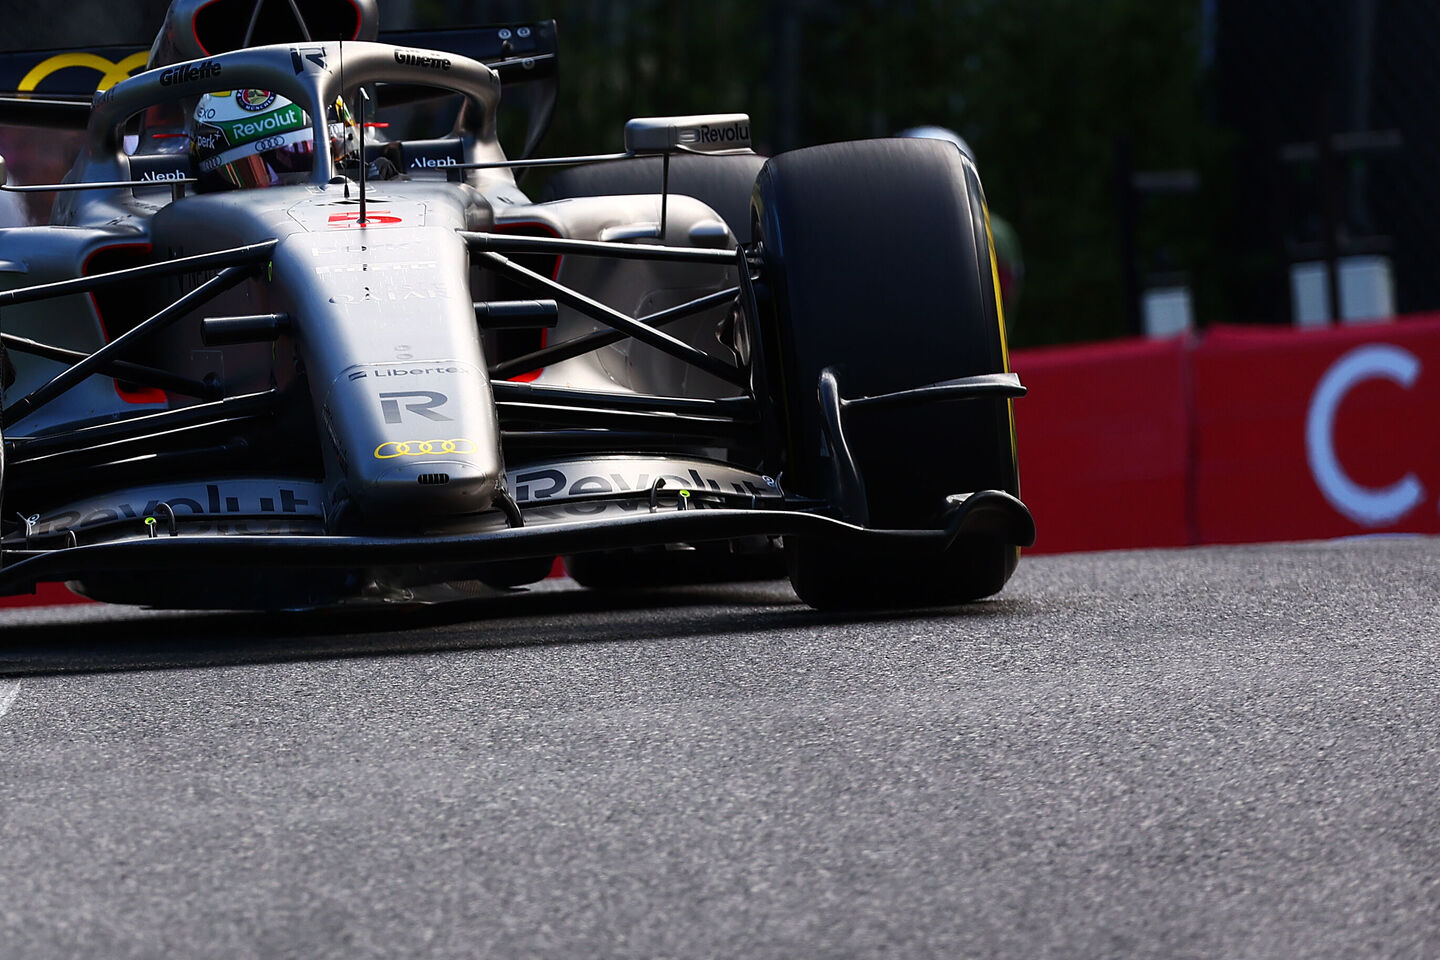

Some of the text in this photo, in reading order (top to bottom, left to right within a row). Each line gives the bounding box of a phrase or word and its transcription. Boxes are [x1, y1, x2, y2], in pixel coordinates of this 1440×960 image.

[160, 61, 221, 87] Gillette
[232, 109, 298, 139] Revolut
[701, 123, 750, 143] Revolu
[410, 156, 457, 168] Aleph
[140, 169, 187, 182] Aleph
[375, 366, 468, 378] Liberte
[379, 390, 456, 425] R
[516, 468, 769, 517] Revolut
